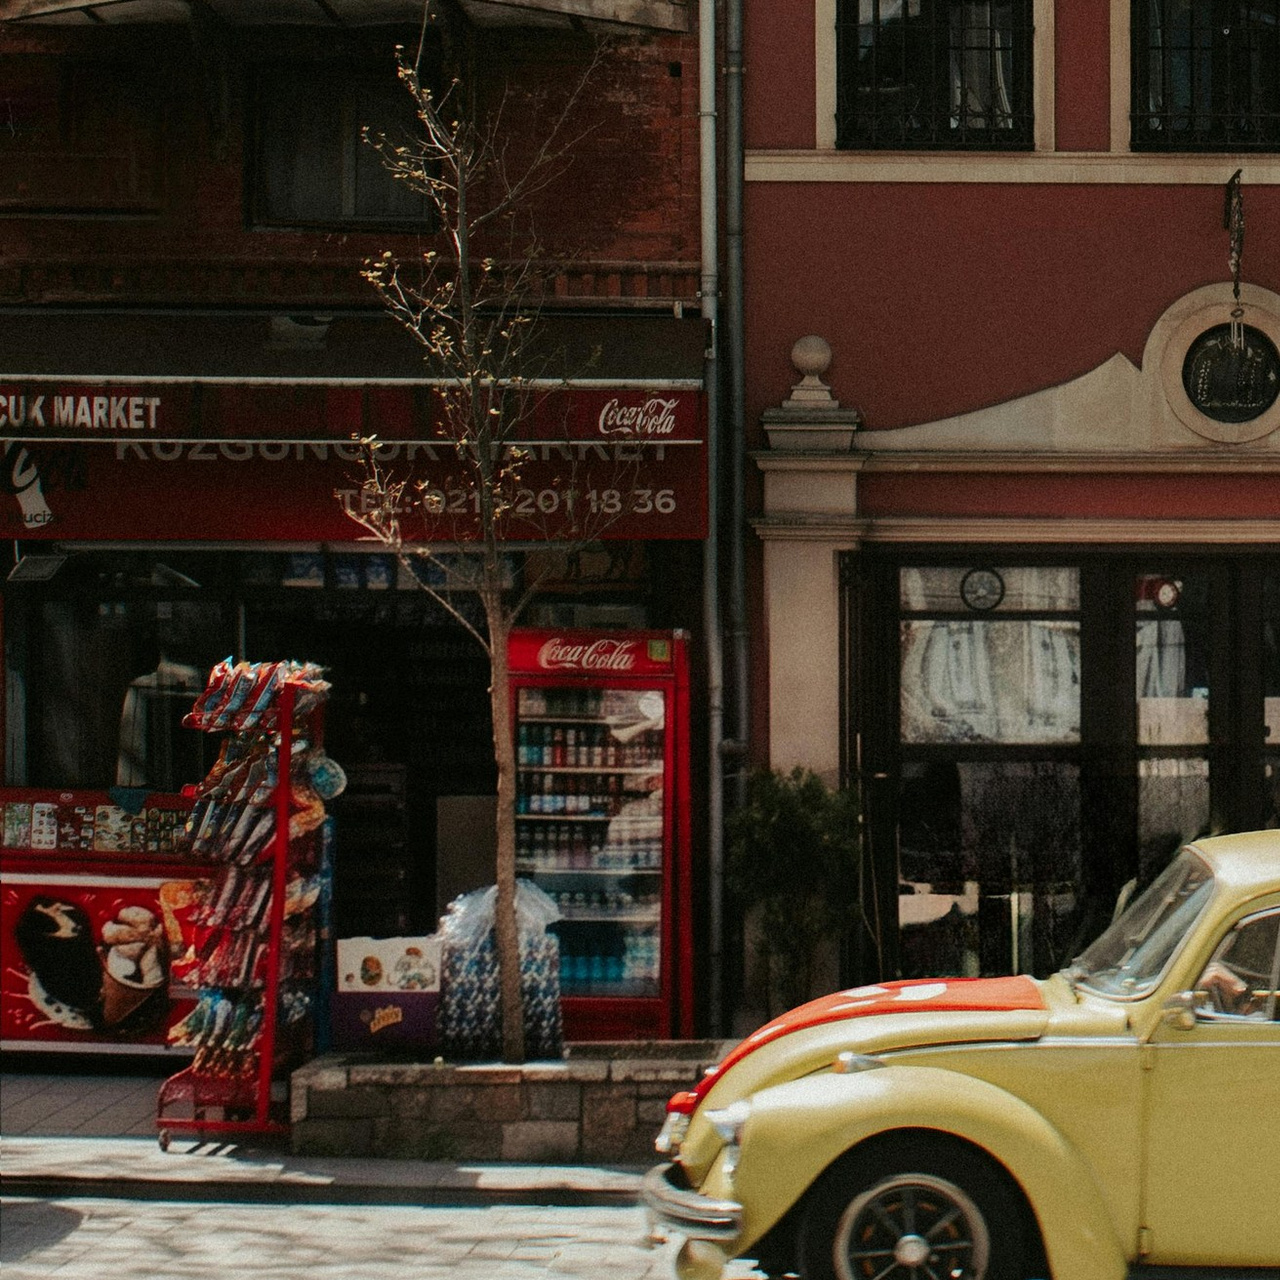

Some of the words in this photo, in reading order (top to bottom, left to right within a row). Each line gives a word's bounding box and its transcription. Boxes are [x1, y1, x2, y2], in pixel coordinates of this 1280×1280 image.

[53, 395, 161, 430] MARKET
[515, 488, 574, 514] 201
[585, 488, 623, 514] 18
[632, 488, 677, 514] 36
[537, 637, 638, 670] Coca-Cola
